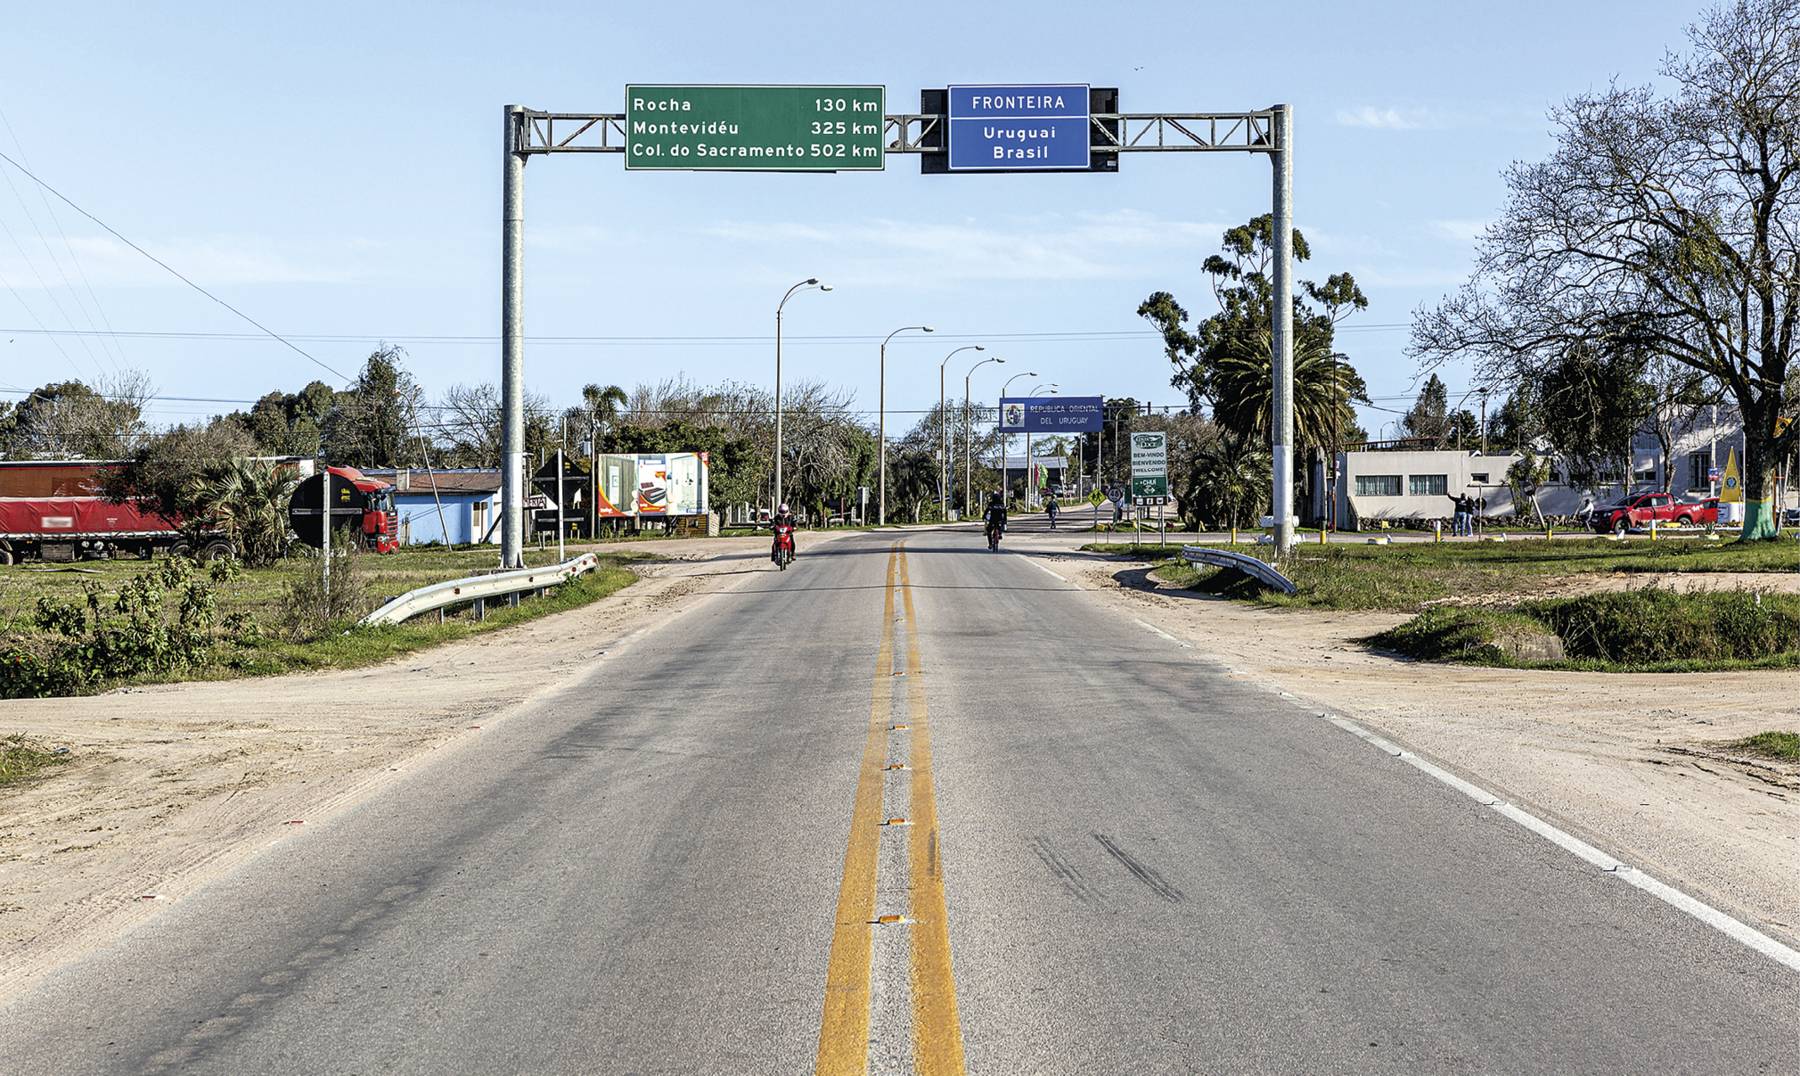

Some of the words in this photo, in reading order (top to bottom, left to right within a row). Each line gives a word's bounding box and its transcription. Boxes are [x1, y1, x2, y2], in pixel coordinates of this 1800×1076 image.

[633, 97, 691, 112] Rocha
[815, 98, 847, 112] 130
[852, 98, 878, 112] km
[972, 95, 1065, 110] FRONTEIRA
[633, 120, 739, 135] Montevidéu
[810, 121, 847, 135] 325
[852, 121, 878, 135] km
[983, 126, 1056, 143] Uruguai
[632, 142, 665, 157] Col.
[669, 143, 690, 157] do
[696, 143, 805, 157] Sacramento
[810, 143, 846, 157] 502
[852, 143, 878, 157] km
[993, 145, 1048, 159] Brasil
[1068, 405, 1099, 413] ORIENTAL
[1040, 417, 1053, 425] DEL
[1058, 416, 1089, 425] URUGUAY
